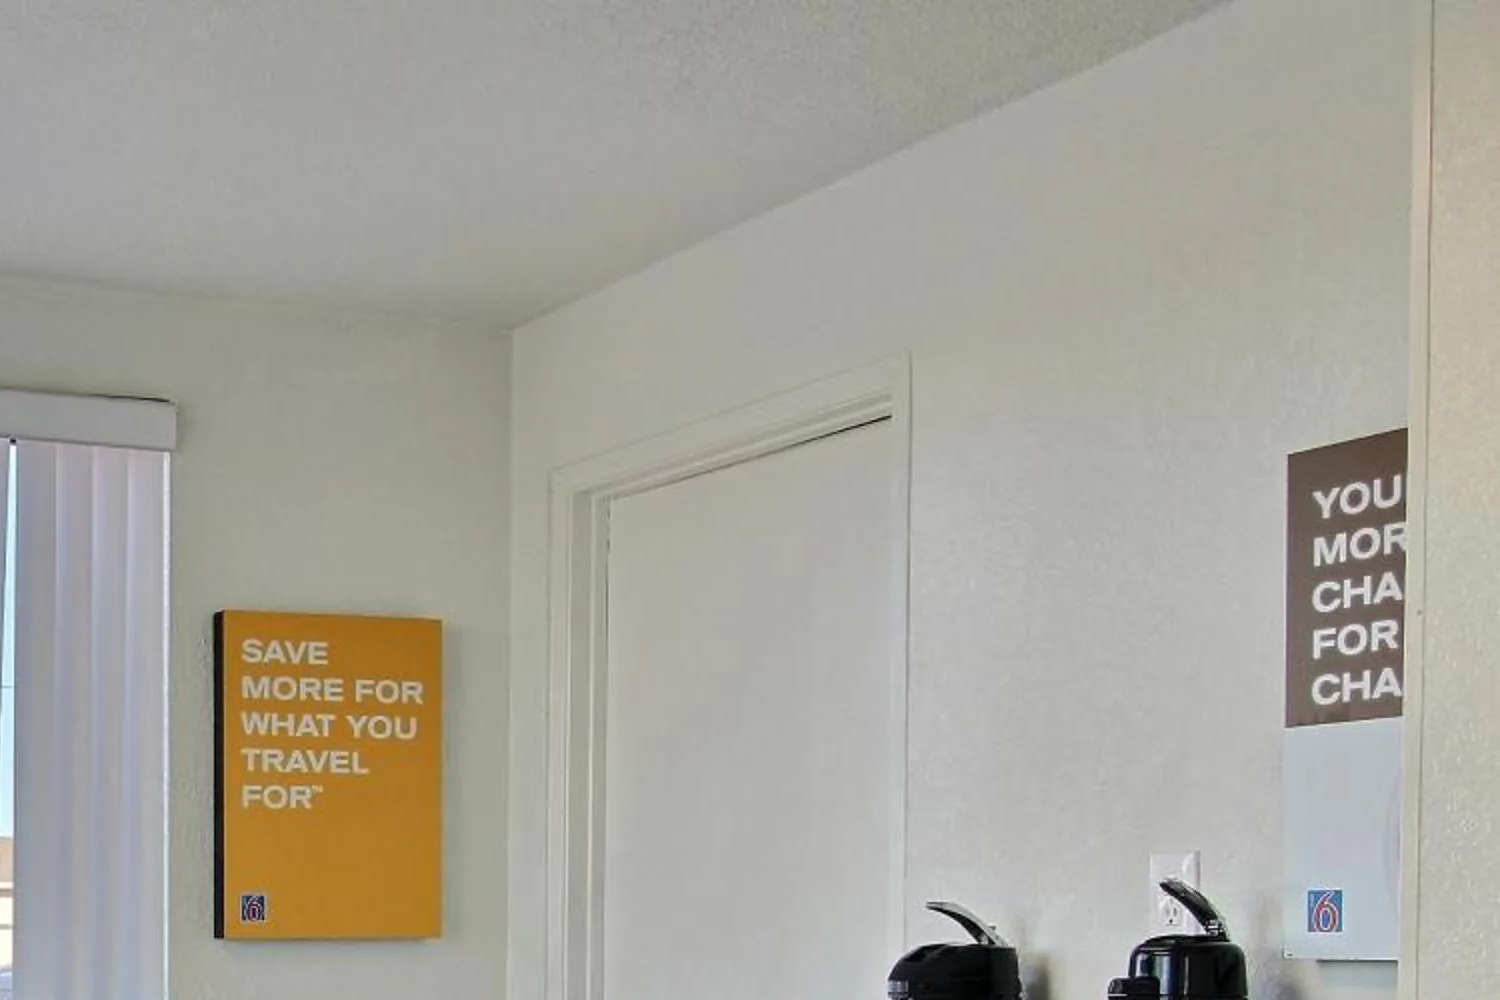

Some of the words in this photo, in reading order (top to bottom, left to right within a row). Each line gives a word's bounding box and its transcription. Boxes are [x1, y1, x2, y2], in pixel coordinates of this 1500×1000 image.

[1312, 474, 1402, 519] YOU
[1311, 571, 1403, 613] CHA
[242, 638, 328, 665] SAVE
[1312, 619, 1399, 660] FOR
[241, 675, 344, 702] MORE
[355, 679, 423, 705] FOR
[1311, 666, 1402, 706] CHA
[241, 712, 336, 738] WHAT
[346, 715, 418, 741] YOU
[241, 748, 370, 775] TRAVEL
